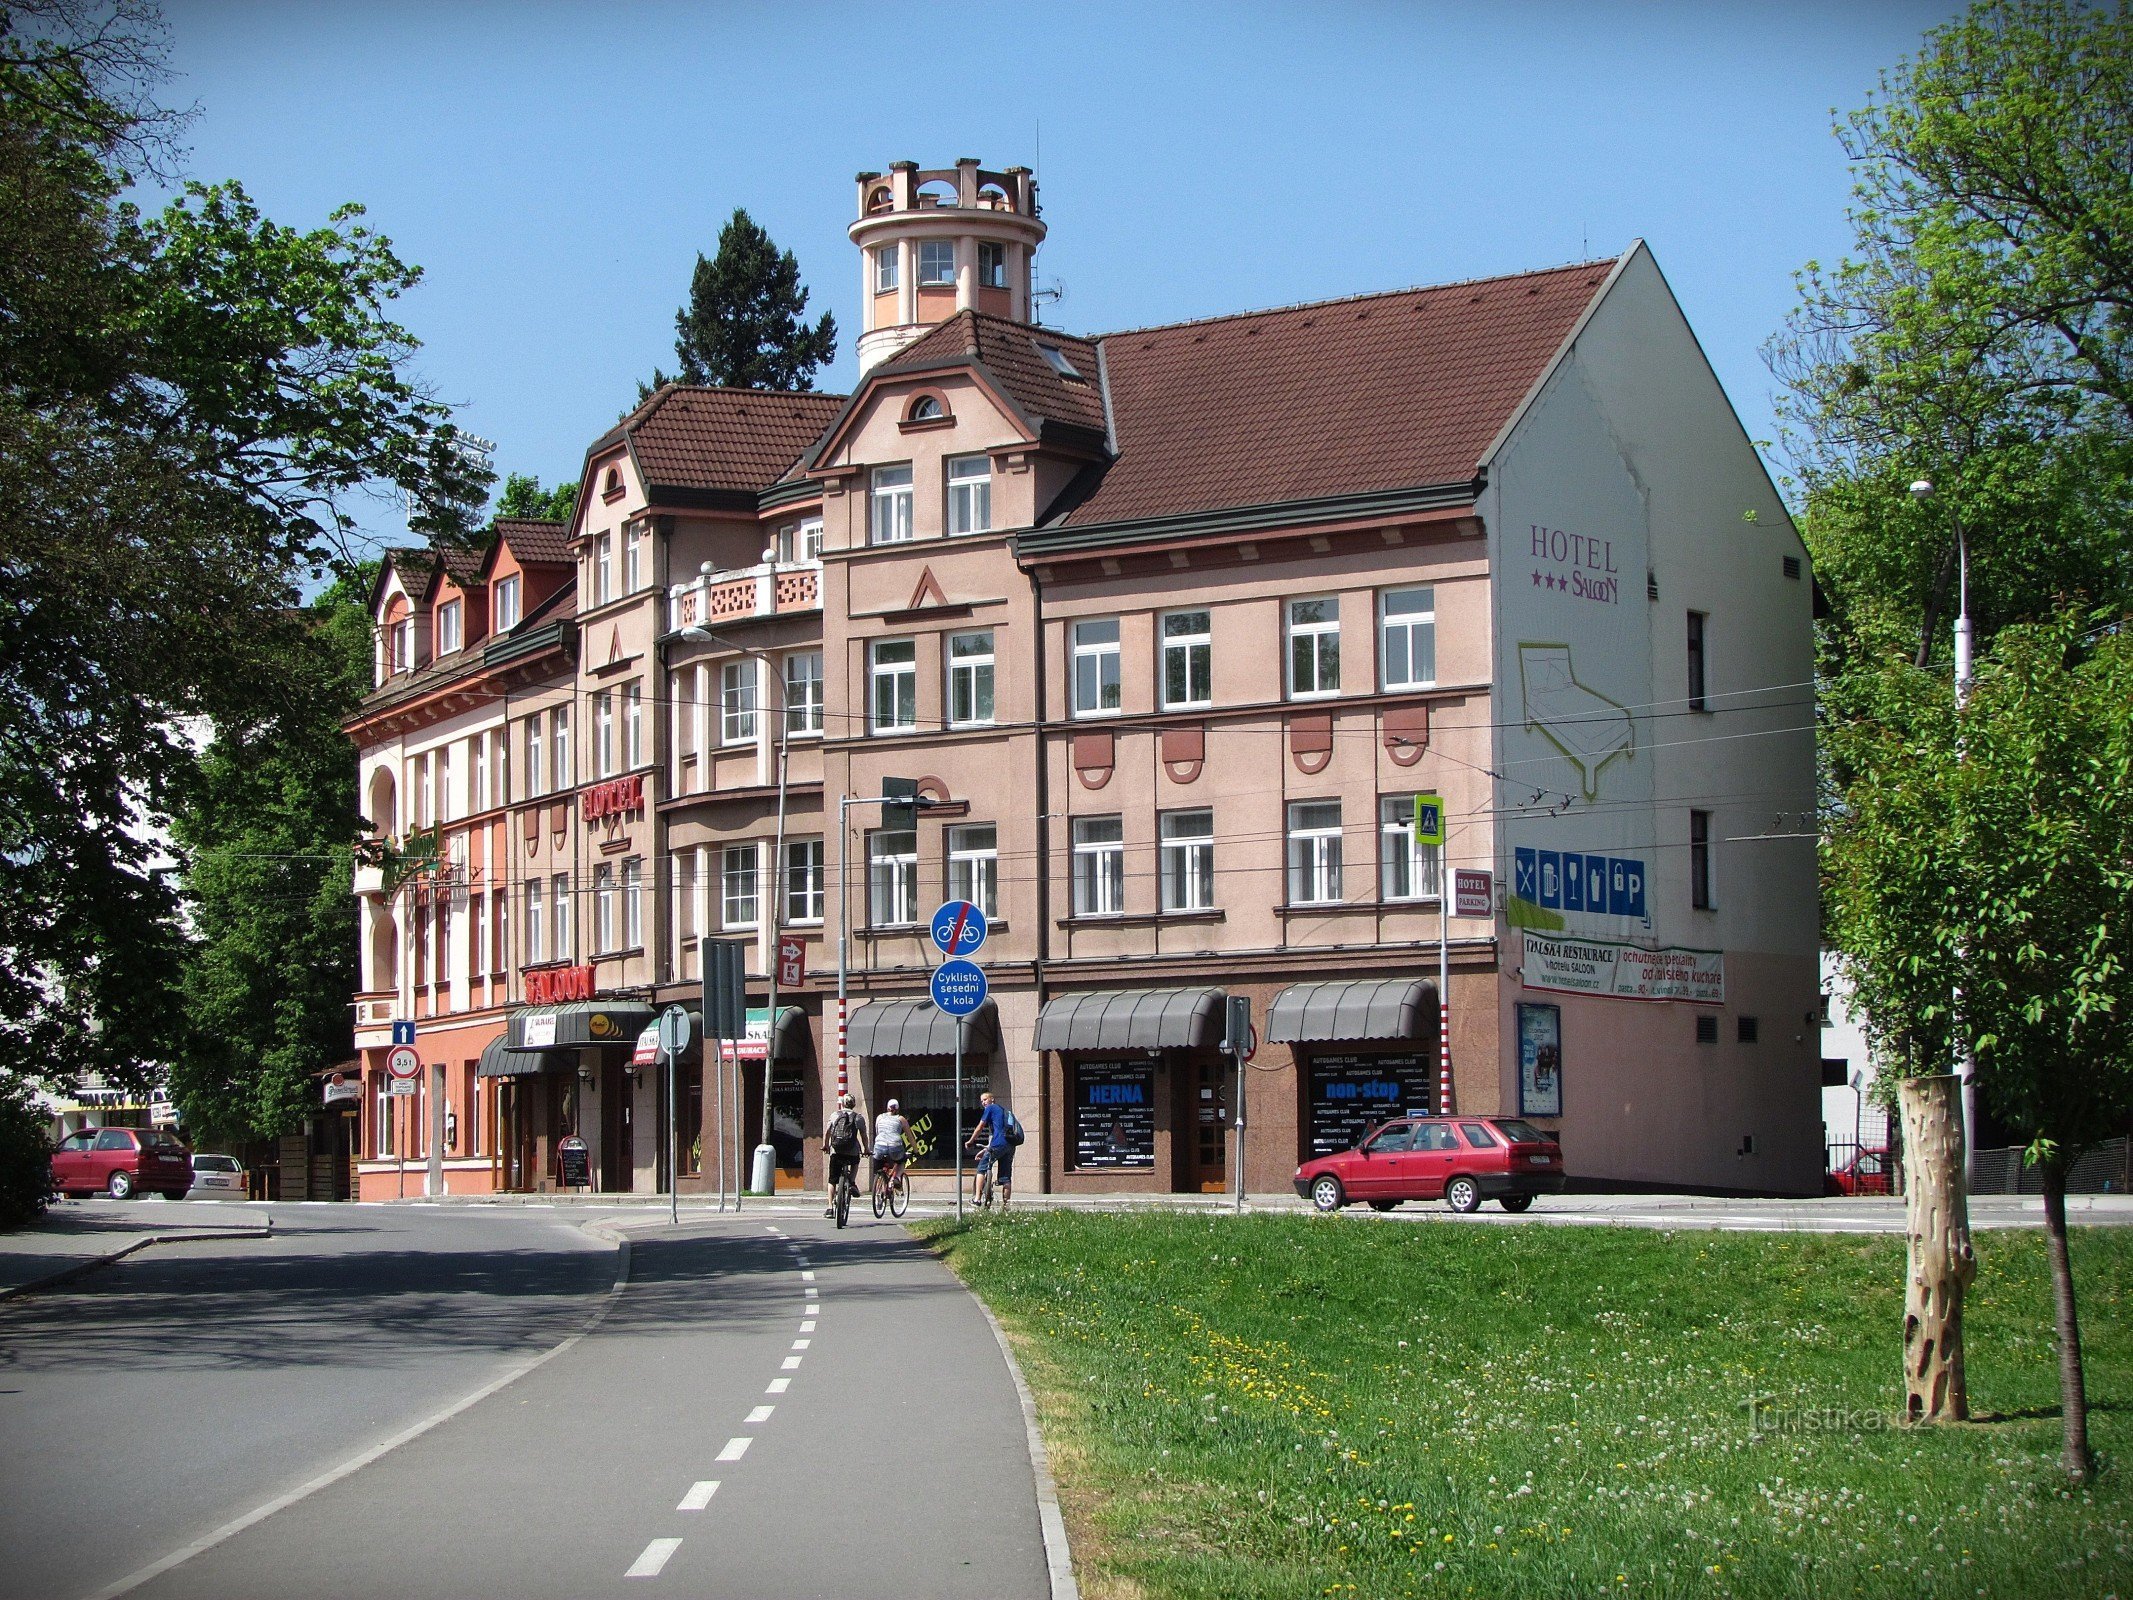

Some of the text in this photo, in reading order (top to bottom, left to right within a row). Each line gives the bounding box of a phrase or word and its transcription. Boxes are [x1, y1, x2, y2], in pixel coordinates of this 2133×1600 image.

[1530, 525, 1618, 573] HOTEL
[583, 776, 644, 821] HOTEL
[1457, 878, 1486, 890] HOTEL
[1458, 897, 1486, 908] PARKING
[1562, 945, 1614, 963] RESTAURACE
[1549, 959, 1570, 972] hotelu
[1571, 963, 1596, 974] SALOON
[1642, 968, 1654, 980] od
[525, 965, 596, 1005] SALOON
[941, 983, 979, 993] sesedni
[1541, 974, 1599, 989] www.hotelsaloon.cz
[943, 996, 974, 1005] z kola
[1089, 1084, 1144, 1104] HERNA
[1326, 1078, 1400, 1102] non-stop
